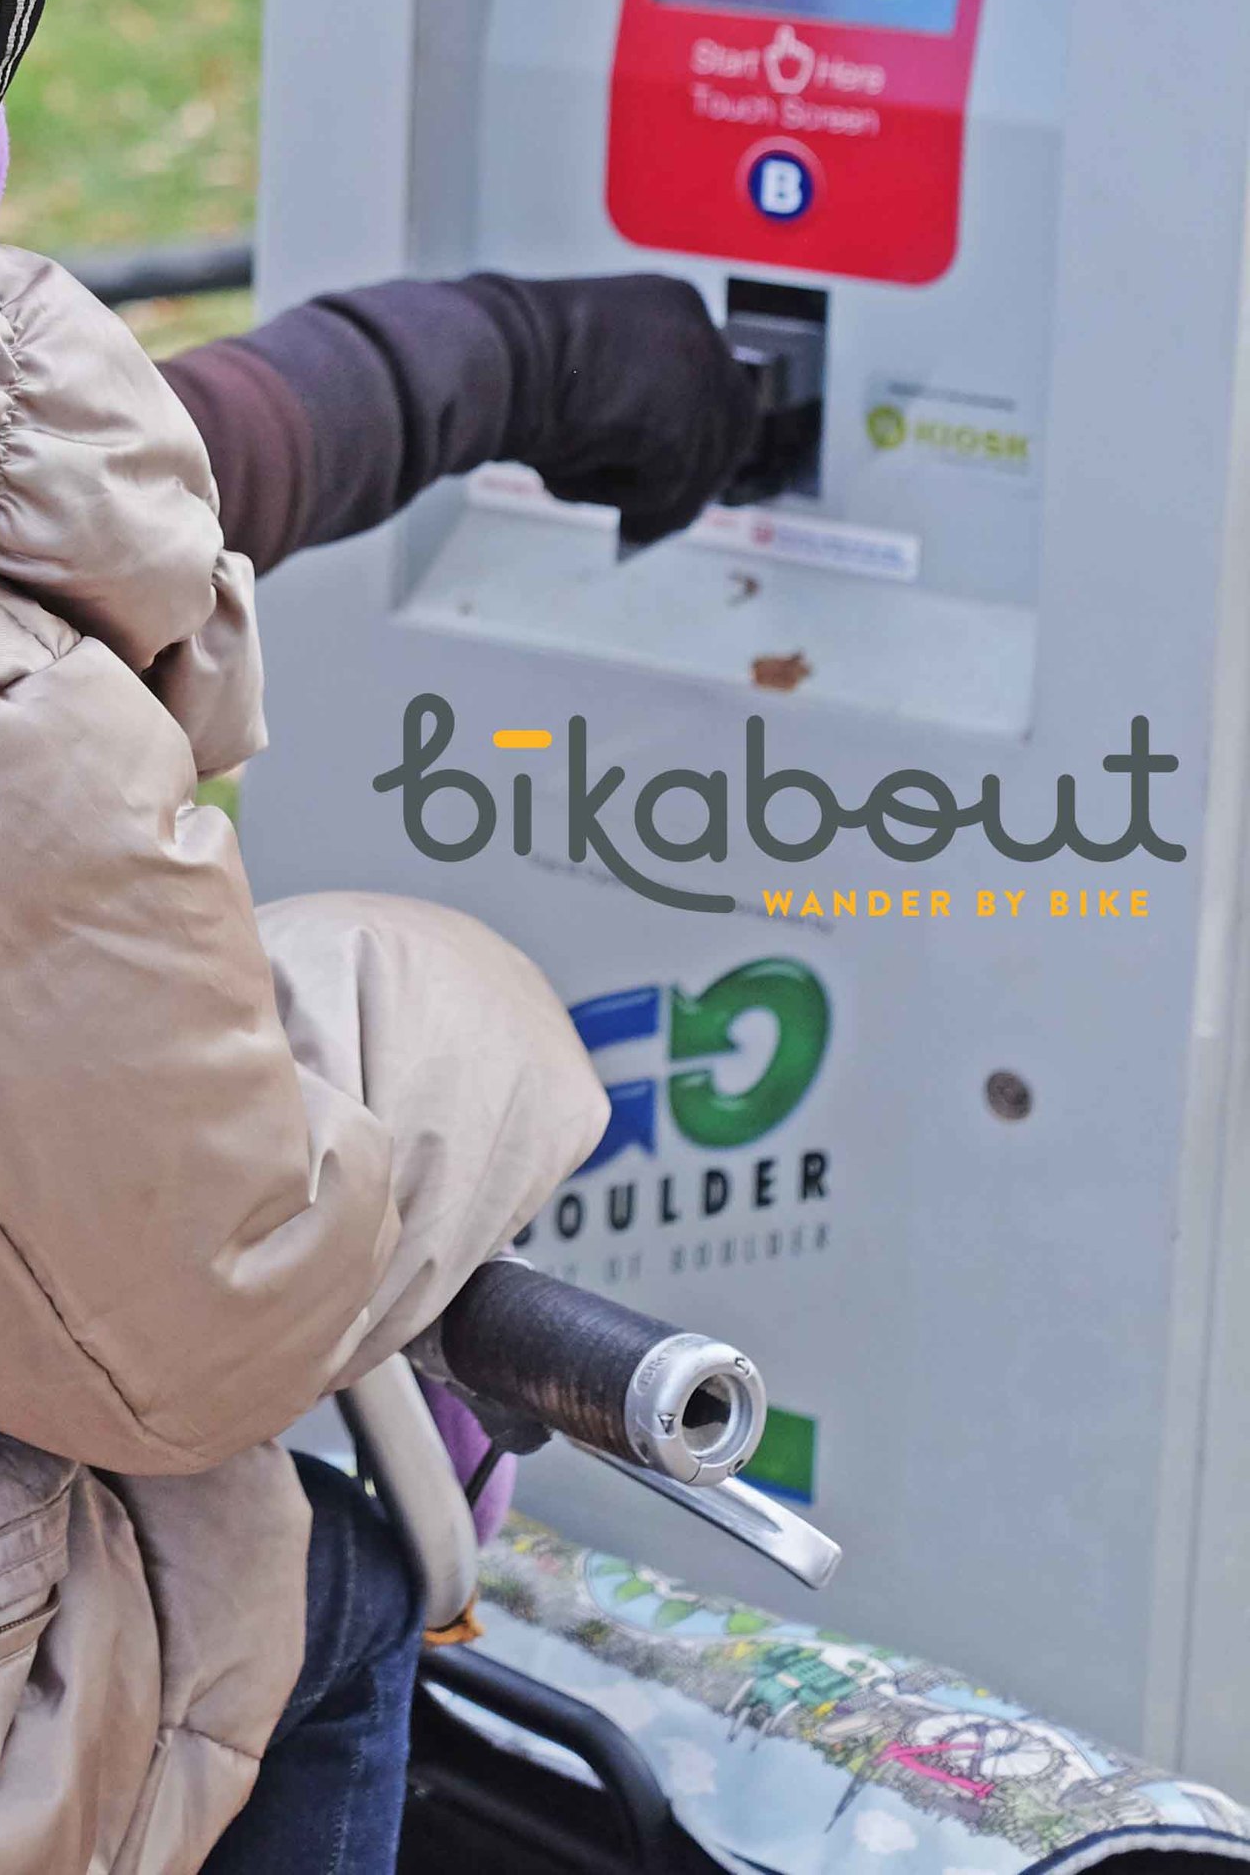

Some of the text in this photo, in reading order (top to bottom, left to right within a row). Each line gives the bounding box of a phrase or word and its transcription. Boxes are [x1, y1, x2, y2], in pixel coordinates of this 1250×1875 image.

[690, 38, 887, 96] Start Here
[691, 82, 881, 137] Touch Screen
